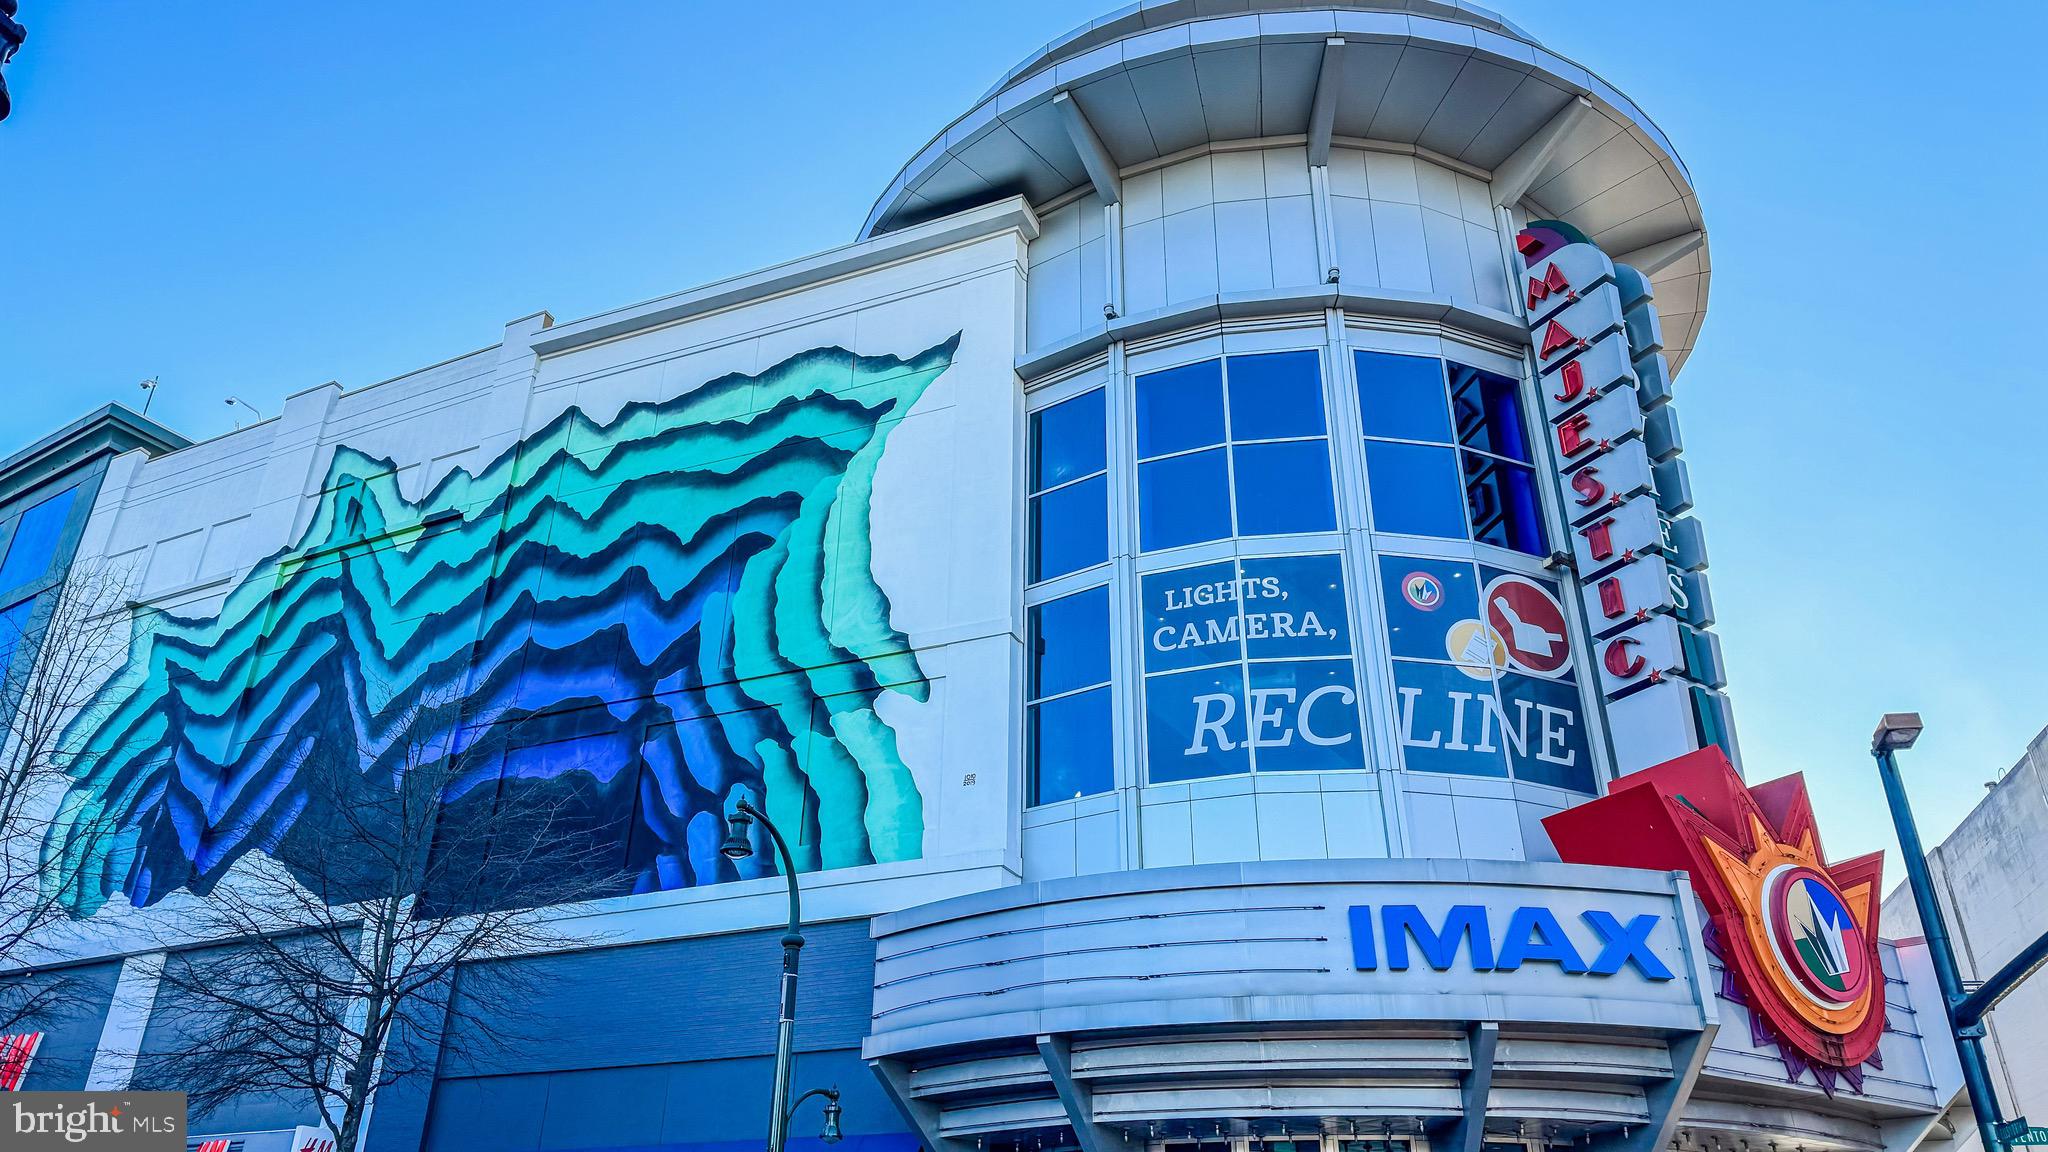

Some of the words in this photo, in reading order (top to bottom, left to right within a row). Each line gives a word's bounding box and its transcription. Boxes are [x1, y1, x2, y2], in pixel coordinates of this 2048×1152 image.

[1527, 261, 1645, 679] MAJESTIC
[1164, 576, 1289, 612] LIGHTS,
[1152, 611, 1338, 653] CAMERA,
[1348, 904, 1676, 982] IMAX
